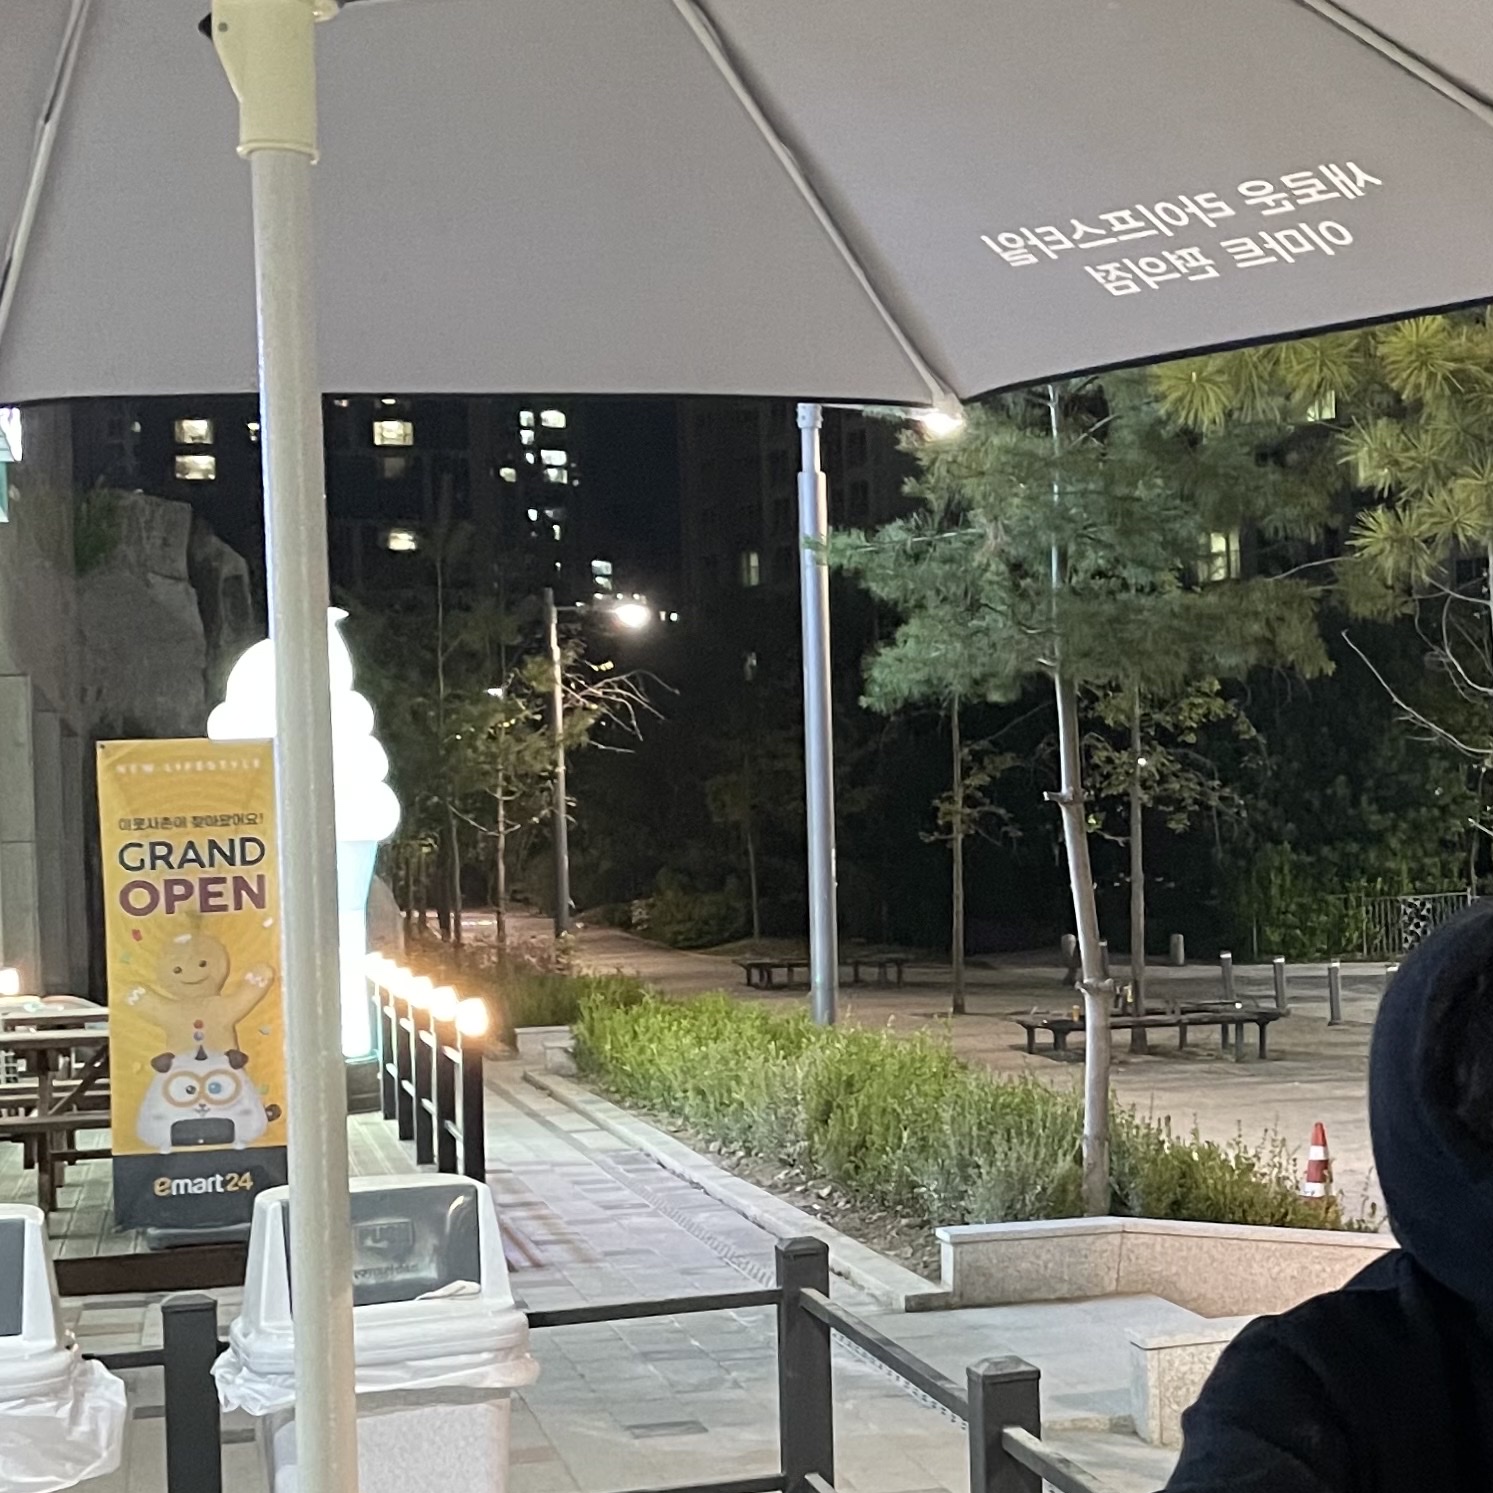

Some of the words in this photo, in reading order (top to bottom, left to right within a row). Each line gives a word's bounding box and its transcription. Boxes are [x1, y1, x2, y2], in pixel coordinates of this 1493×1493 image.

[118, 836, 266, 872] GRAND
[118, 873, 267, 917] OPEN
[153, 1171, 254, 1196] emart24
